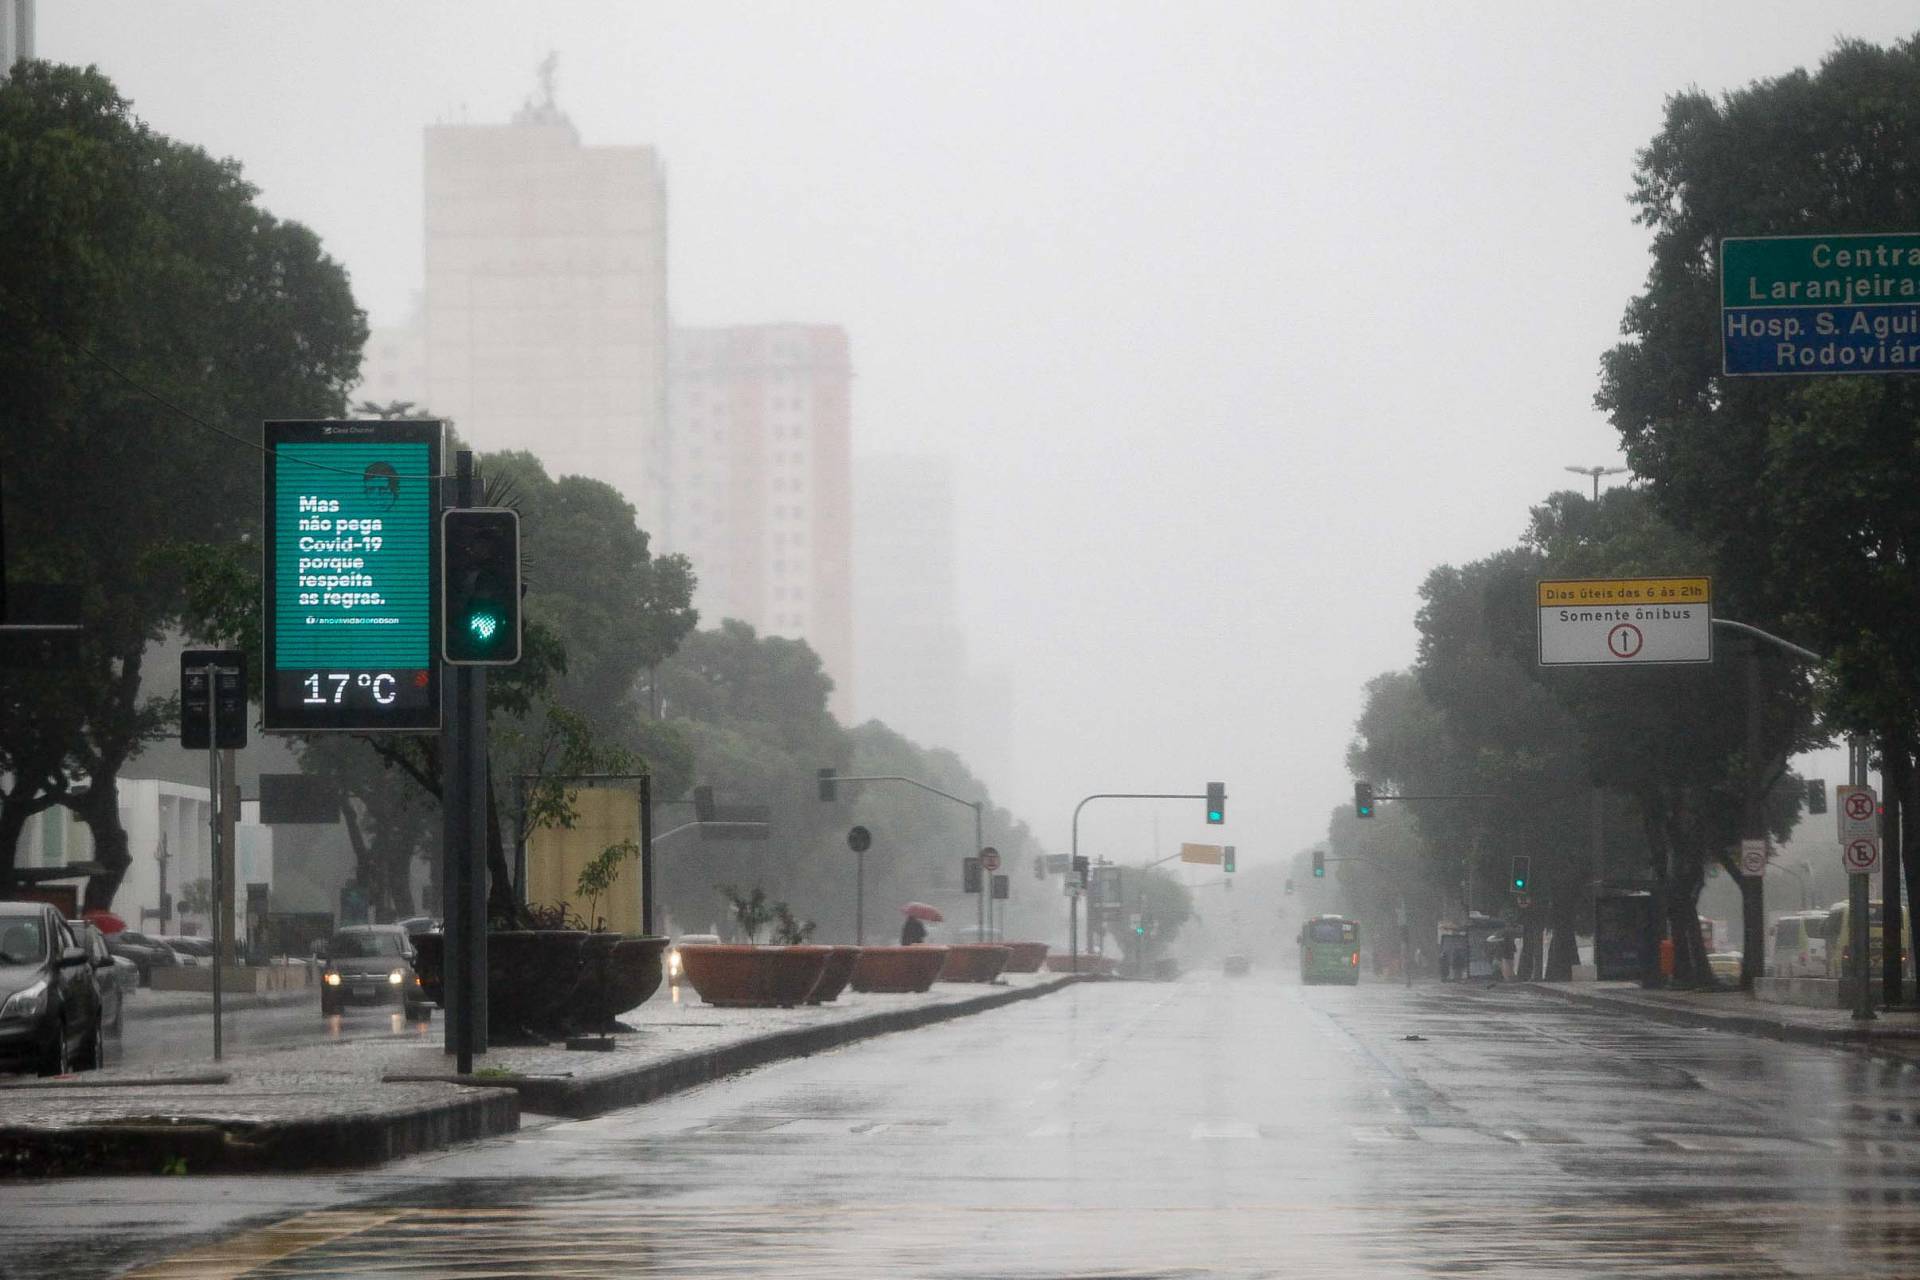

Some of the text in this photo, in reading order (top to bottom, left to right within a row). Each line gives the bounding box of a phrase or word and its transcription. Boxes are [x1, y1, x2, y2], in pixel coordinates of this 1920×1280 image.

[1812, 244, 1920, 268] Centra
[1727, 313, 1805, 341] Hosp.
[1816, 311, 1840, 335] S.
[299, 496, 340, 512] Mas
[299, 515, 382, 535] não pega
[299, 536, 383, 552] Covid-19
[299, 556, 364, 573] porque
[299, 571, 372, 590] respeita
[299, 592, 386, 608] as regras.
[1546, 589, 1575, 600] Dias
[1580, 587, 1613, 599] úteis
[1617, 587, 1640, 598] das
[1647, 587, 1655, 597] 6
[1681, 586, 1702, 596] 21h
[1559, 608, 1691, 622] Somente ônibus
[304, 673, 397, 704] 17°C
